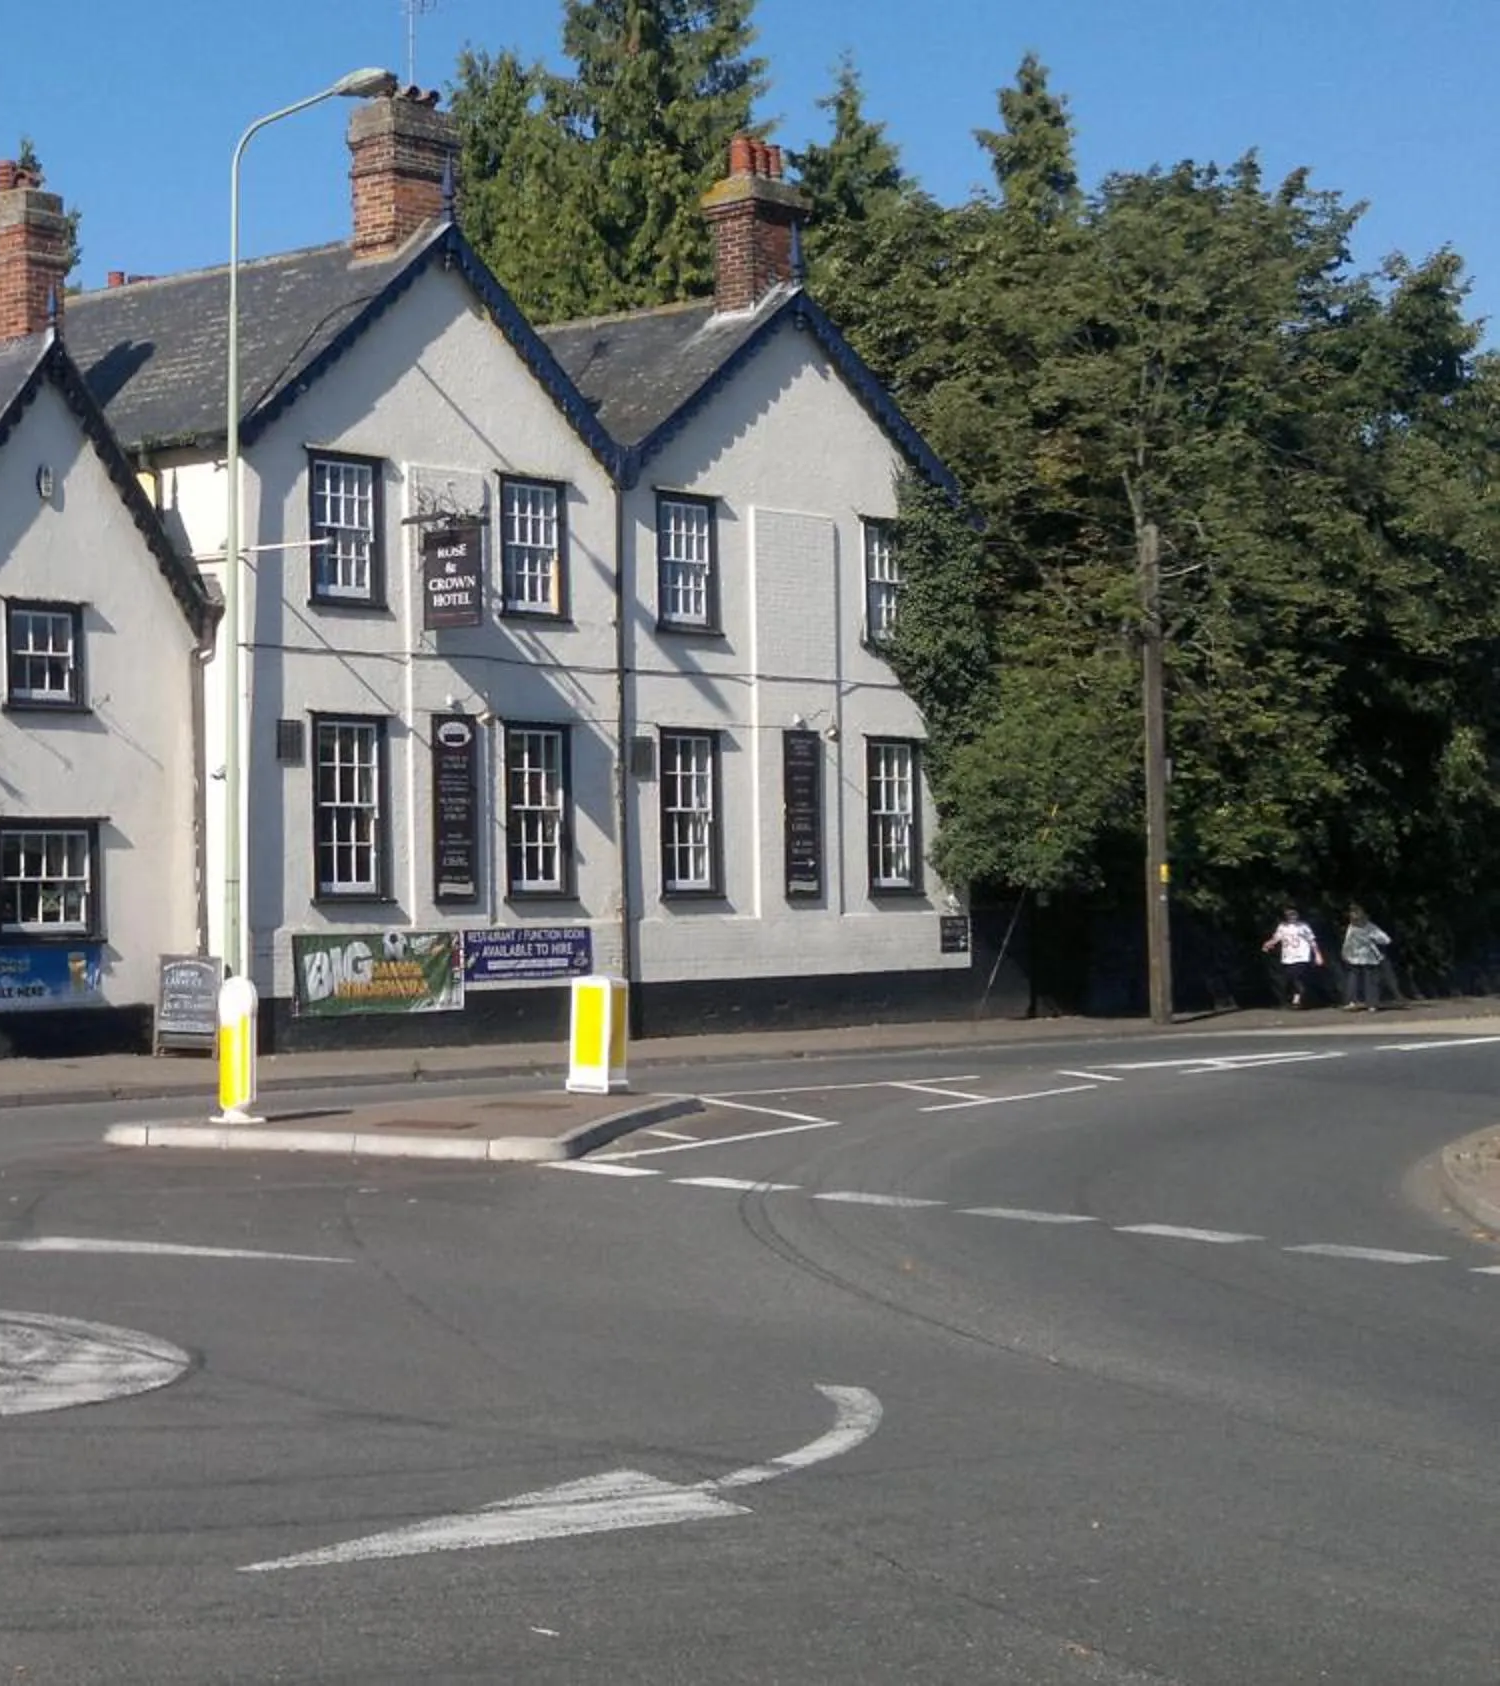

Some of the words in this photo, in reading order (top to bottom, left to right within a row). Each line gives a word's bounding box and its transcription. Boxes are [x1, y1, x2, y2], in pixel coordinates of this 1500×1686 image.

[437, 543, 467, 558] ROSE
[445, 561, 457, 574] &
[428, 575, 476, 591] CROWN
[433, 592, 472, 607] HOTEL
[467, 929, 516, 943] RESTAURANT
[523, 928, 561, 942] FUNCTION
[563, 927, 586, 940] ROOM
[481, 943, 533, 958] AVAILABLE
[535, 942, 549, 956] TO
[551, 941, 574, 956] HIRE
[304, 940, 373, 1001] BIG
